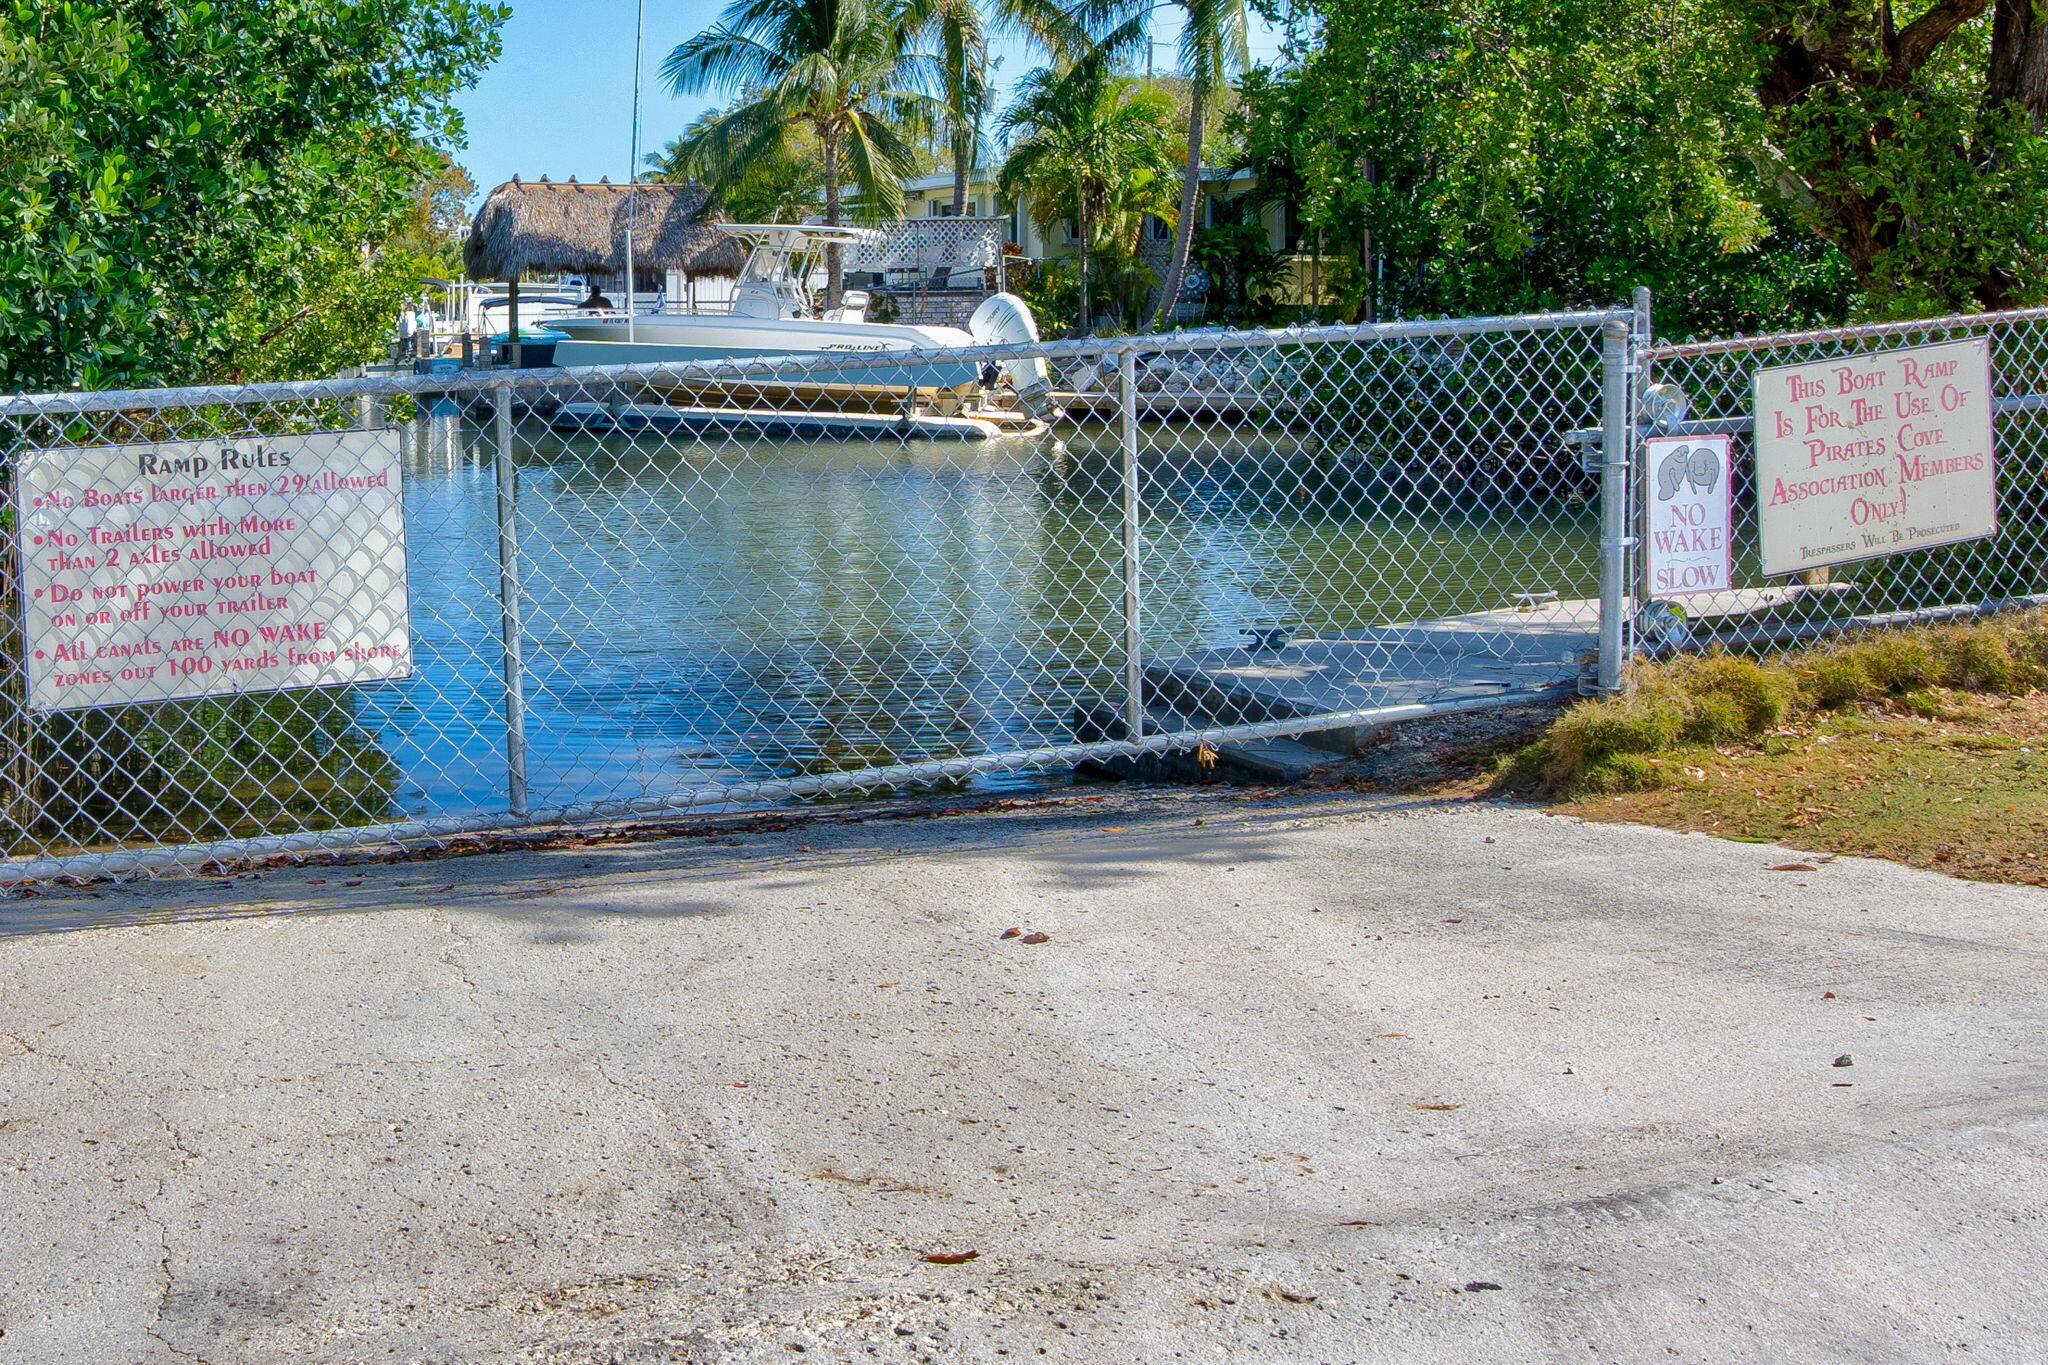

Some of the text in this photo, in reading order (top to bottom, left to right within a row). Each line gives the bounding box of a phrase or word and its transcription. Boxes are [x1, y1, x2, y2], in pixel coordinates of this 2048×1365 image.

[1785, 358, 1959, 402] THIS BOAT RAMP
[1774, 383, 1972, 438] IS FOR THE USE OF
[1803, 423, 1948, 468] PIRATES COVE
[1767, 452, 1984, 507] ASSOCIATION MEMBERS
[1670, 503, 1706, 527] NO
[1654, 527, 1723, 554] WAKE
[1800, 522, 1960, 560] TRESPASSERS WILL BE PROSECUTED
[106, 548, 120, 567] 2
[1656, 565, 1720, 590] SLOW
[213, 628, 250, 649] NO
[259, 621, 326, 644] WAKE
[167, 655, 213, 677] 100
